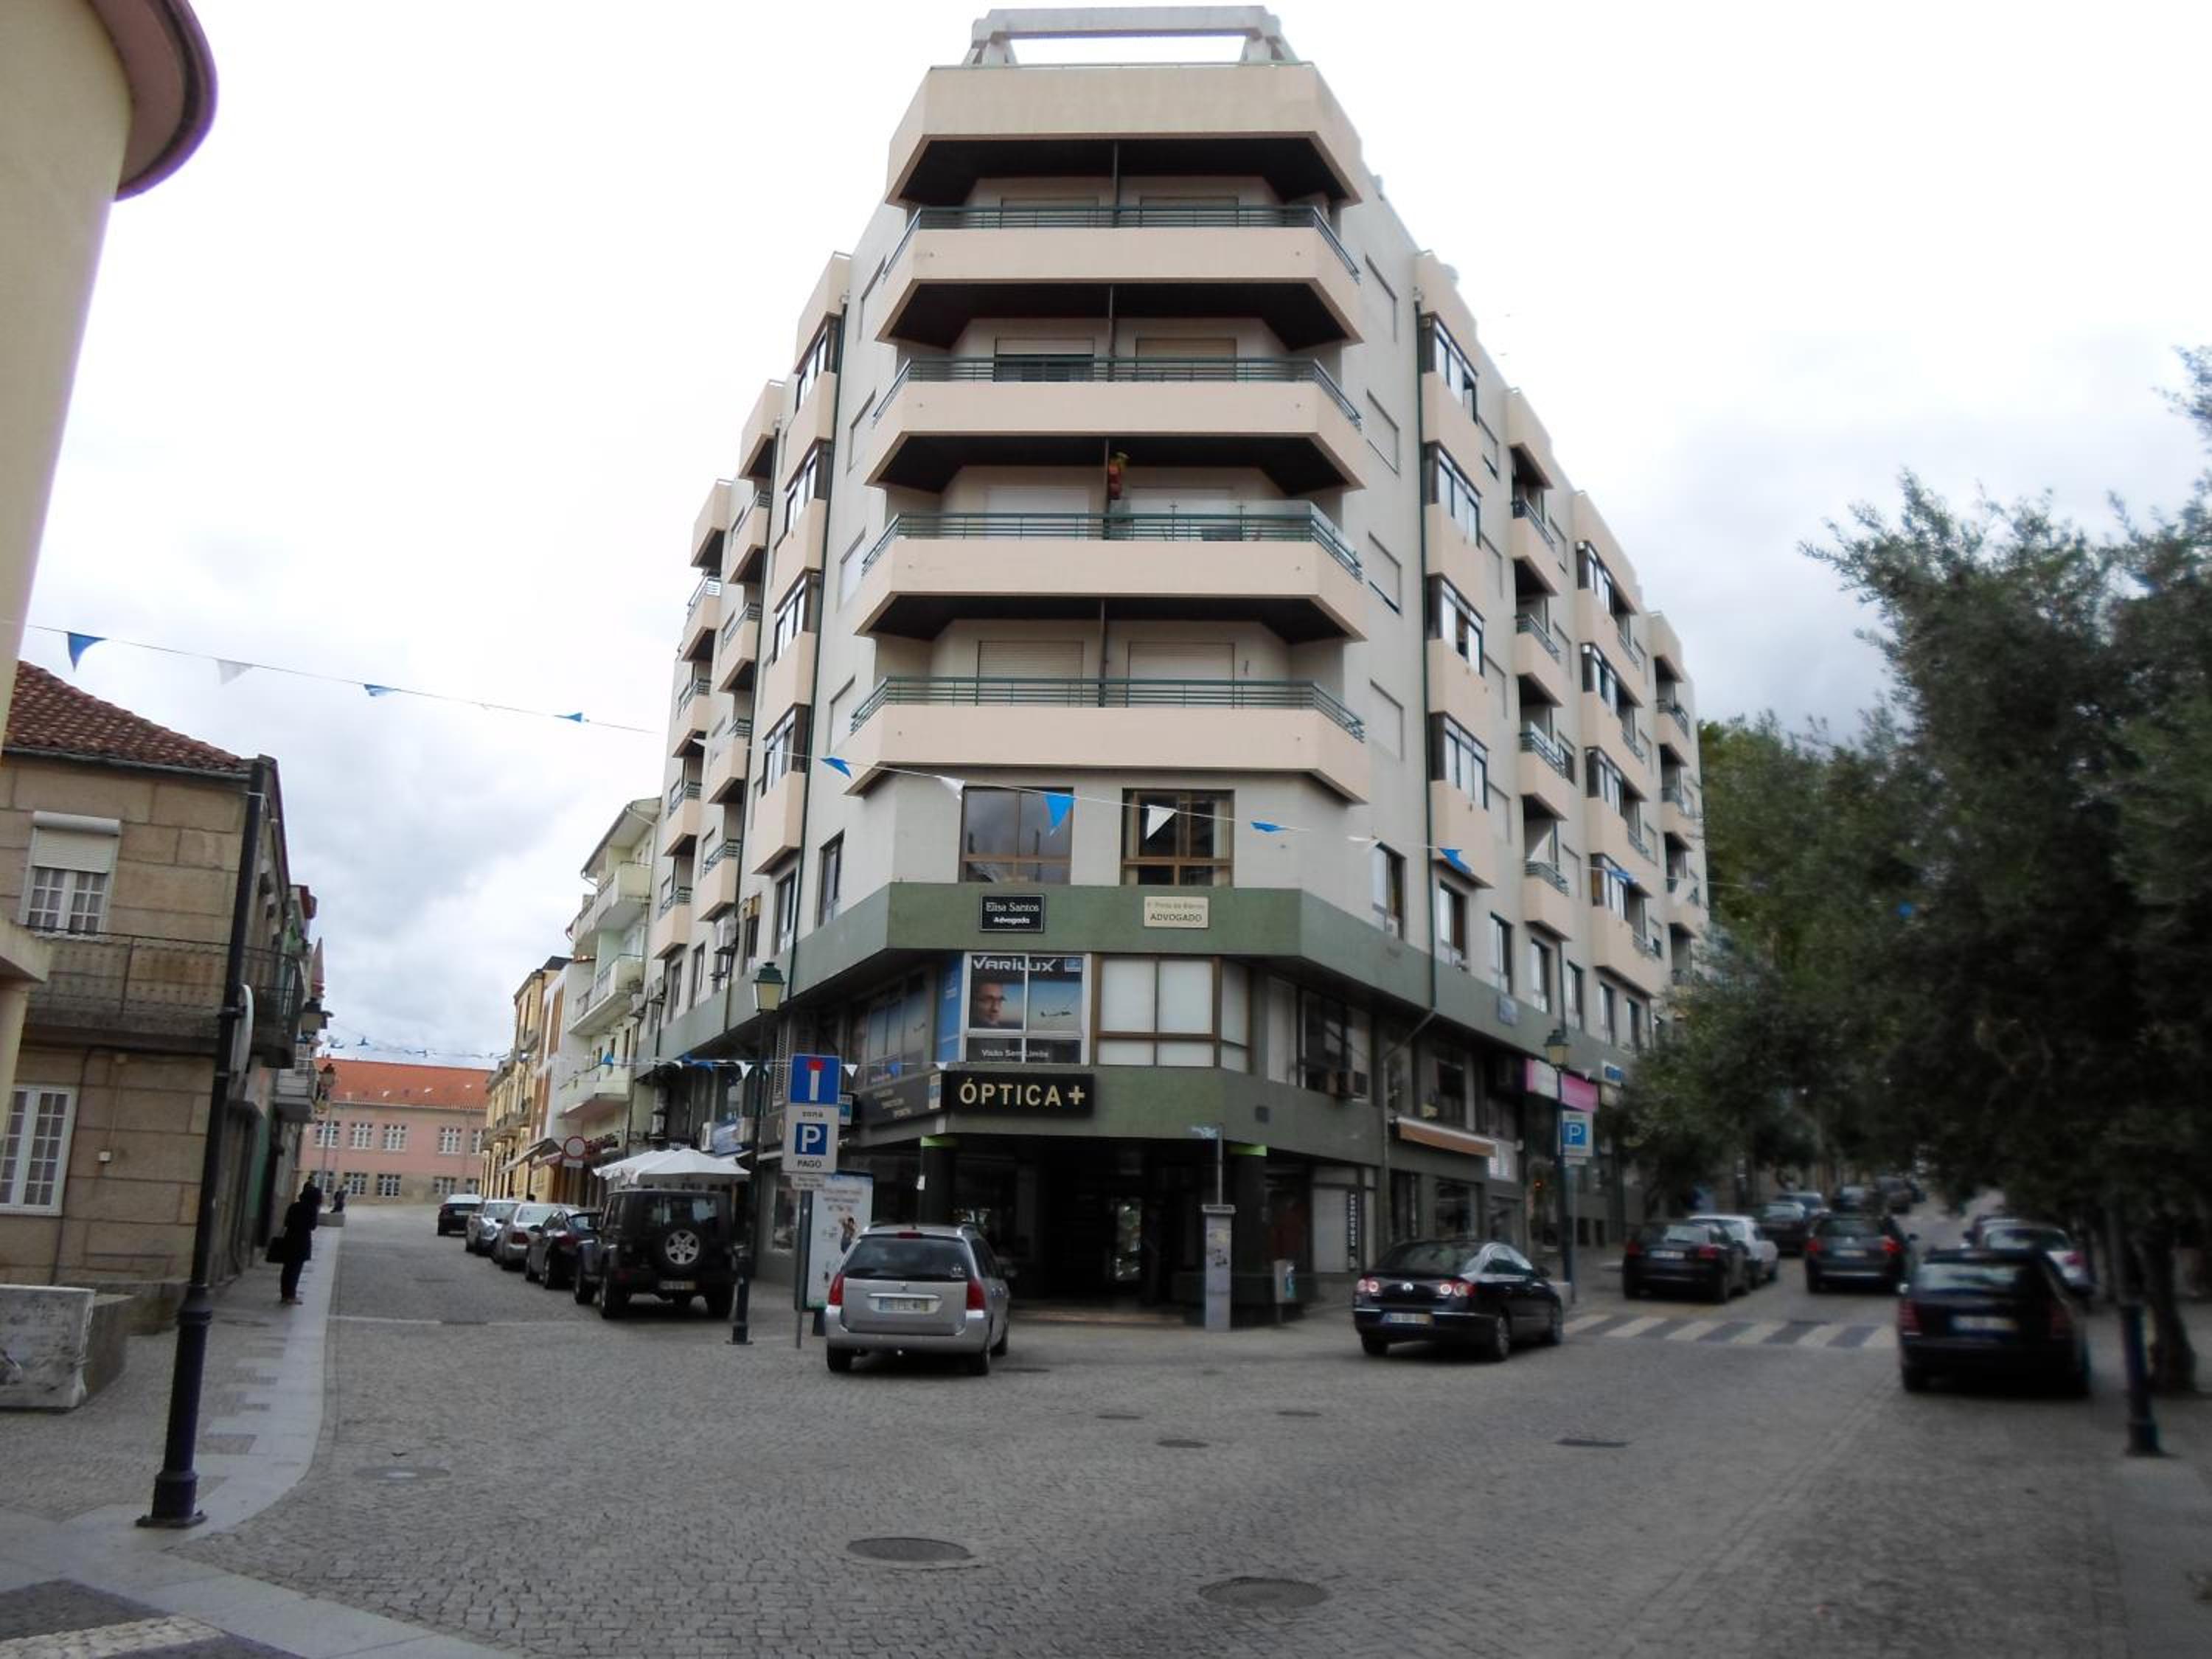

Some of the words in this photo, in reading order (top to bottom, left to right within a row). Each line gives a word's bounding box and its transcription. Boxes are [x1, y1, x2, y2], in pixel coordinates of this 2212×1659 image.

[986, 902, 1007, 912] Elisa
[1009, 901, 1040, 912] Santos
[1150, 913, 1203, 922] ADVOGADO
[801, 1124, 821, 1152] P
[1568, 1124, 1582, 1143] P
[797, 1158, 822, 1169] PAGO
